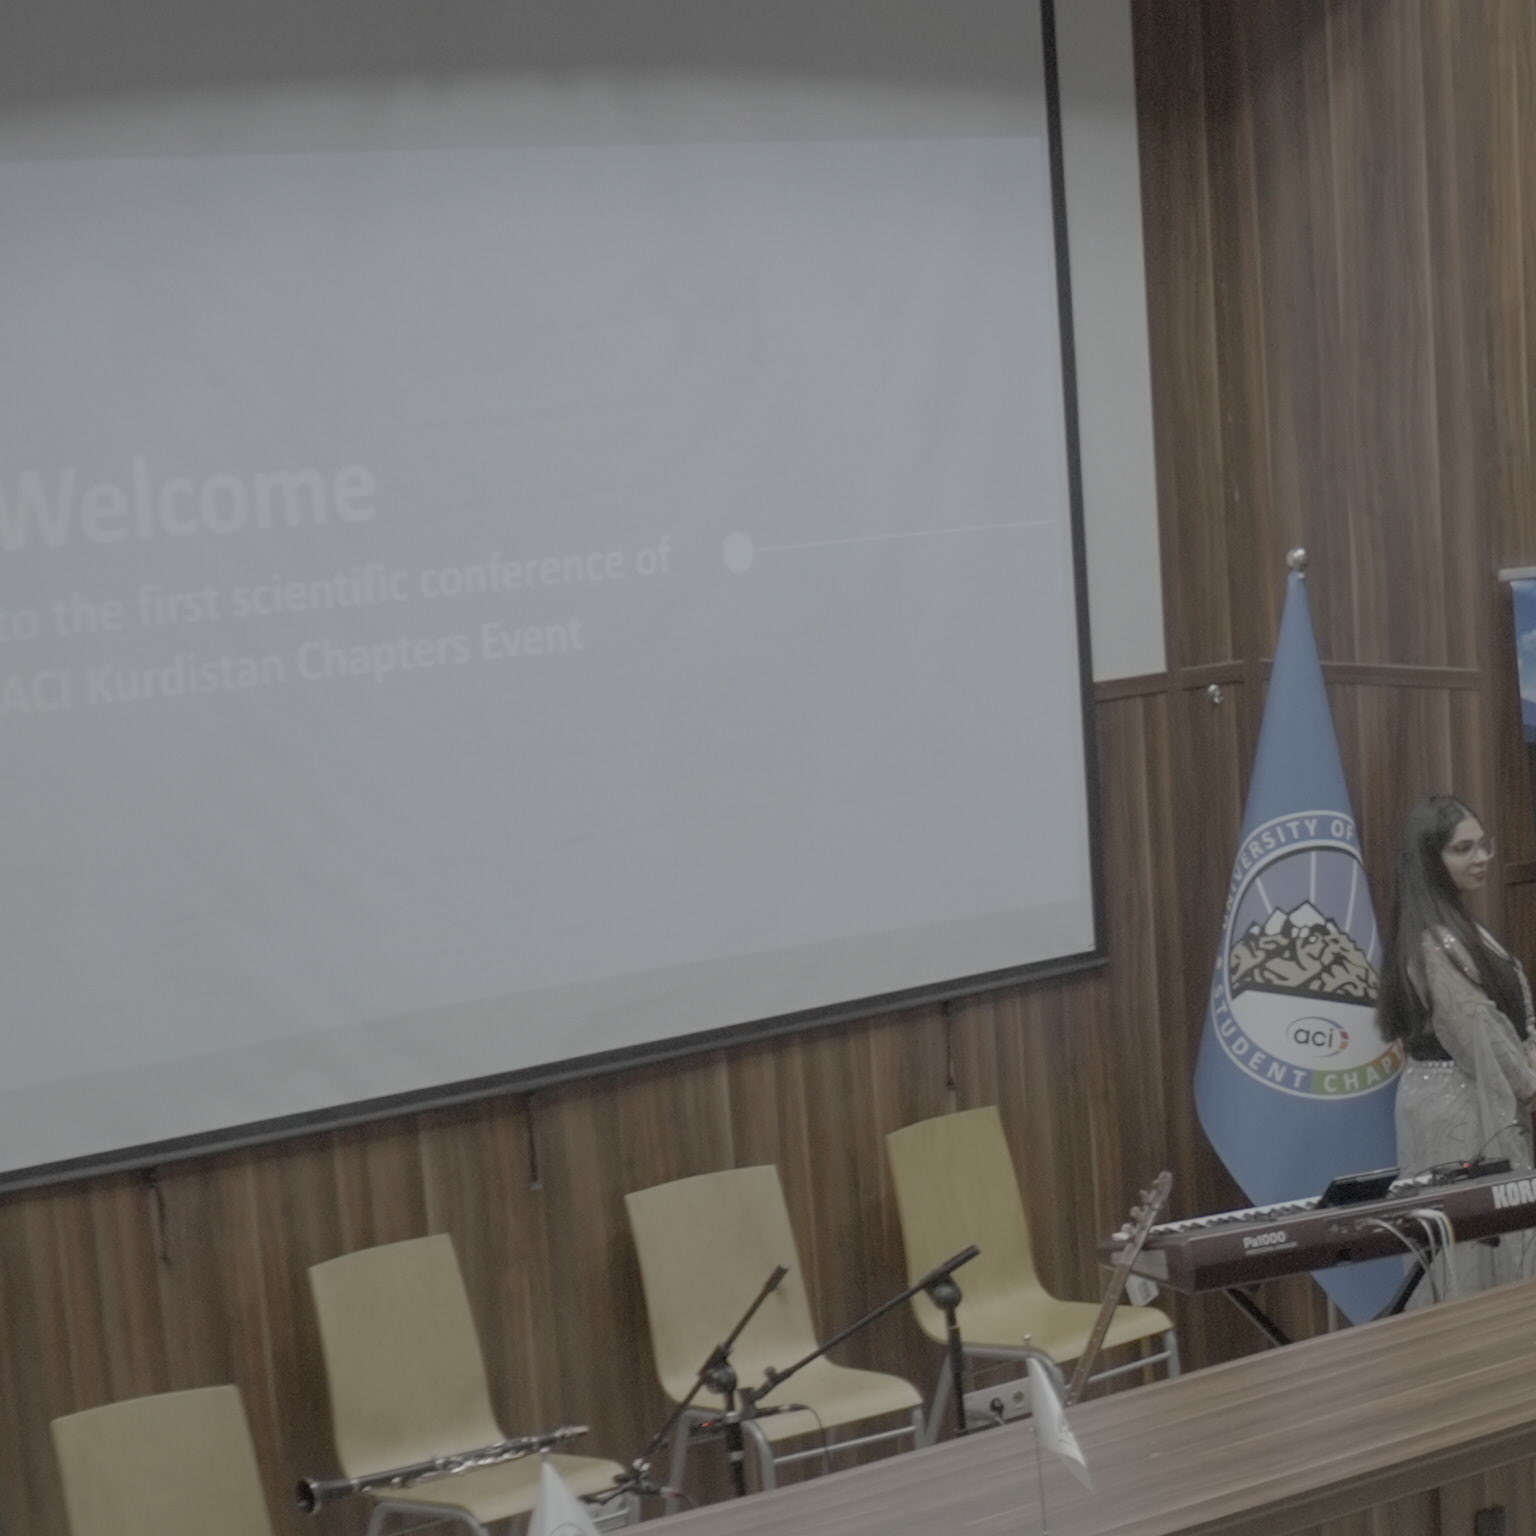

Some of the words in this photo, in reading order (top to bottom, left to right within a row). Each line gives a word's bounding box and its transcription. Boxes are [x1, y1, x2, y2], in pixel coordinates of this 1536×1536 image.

[0, 456, 376, 551] Welcome
[52, 592, 125, 636] the
[138, 583, 221, 627] first
[231, 562, 410, 618] scientific
[419, 551, 625, 599] conference
[635, 533, 673, 577] of
[0, 668, 72, 716] ACI
[85, 652, 287, 706] Kurdistan
[297, 632, 472, 684] Chapters
[481, 616, 584, 660] Event
[1330, 820, 1354, 841] OF
[1214, 985, 1307, 1089] STUDENT
[1294, 1028, 1334, 1048] aci
[1243, 1231, 1287, 1249] Pa1000
